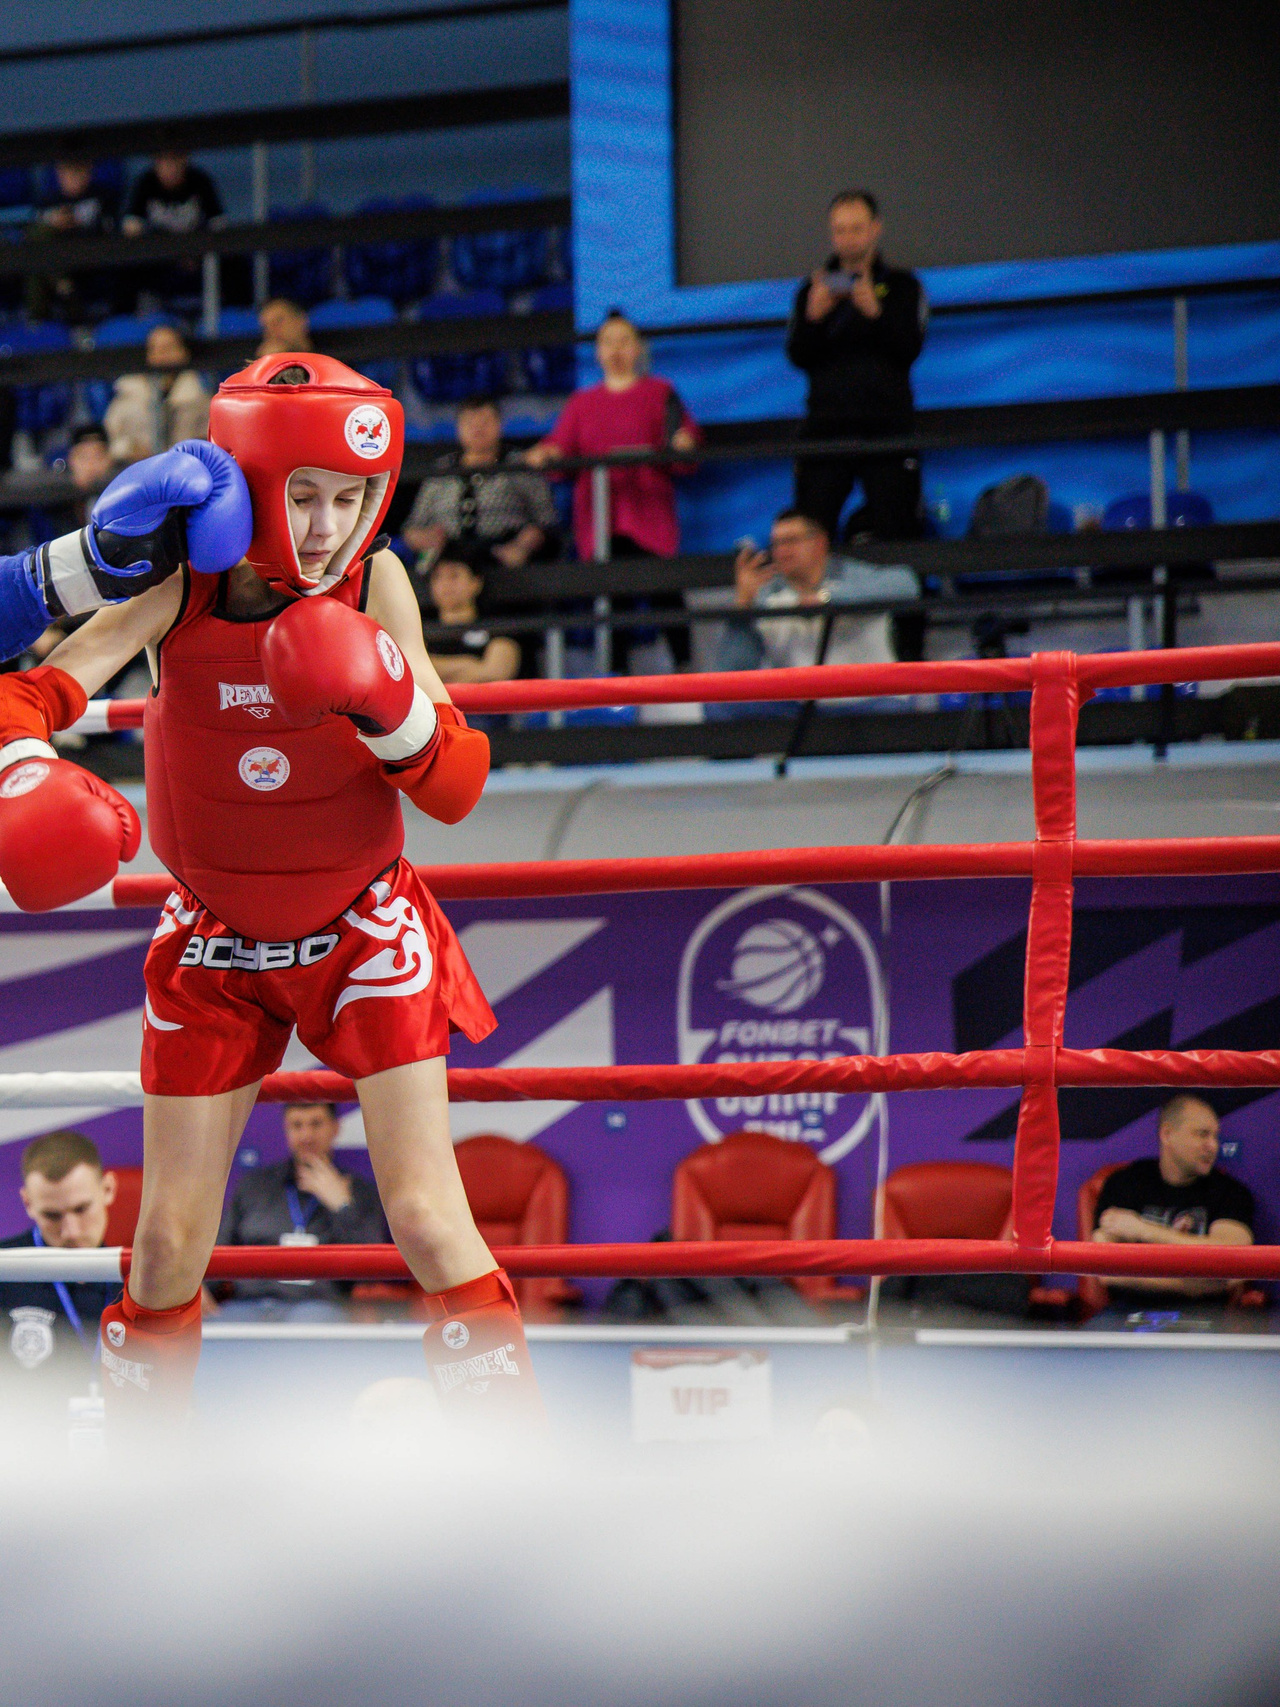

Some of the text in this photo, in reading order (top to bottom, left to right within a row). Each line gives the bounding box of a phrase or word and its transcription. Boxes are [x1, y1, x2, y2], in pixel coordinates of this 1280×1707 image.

[218, 681, 275, 711] REYV
[721, 1018, 841, 1048] FONBET
[672, 1386, 731, 1416] VIP
